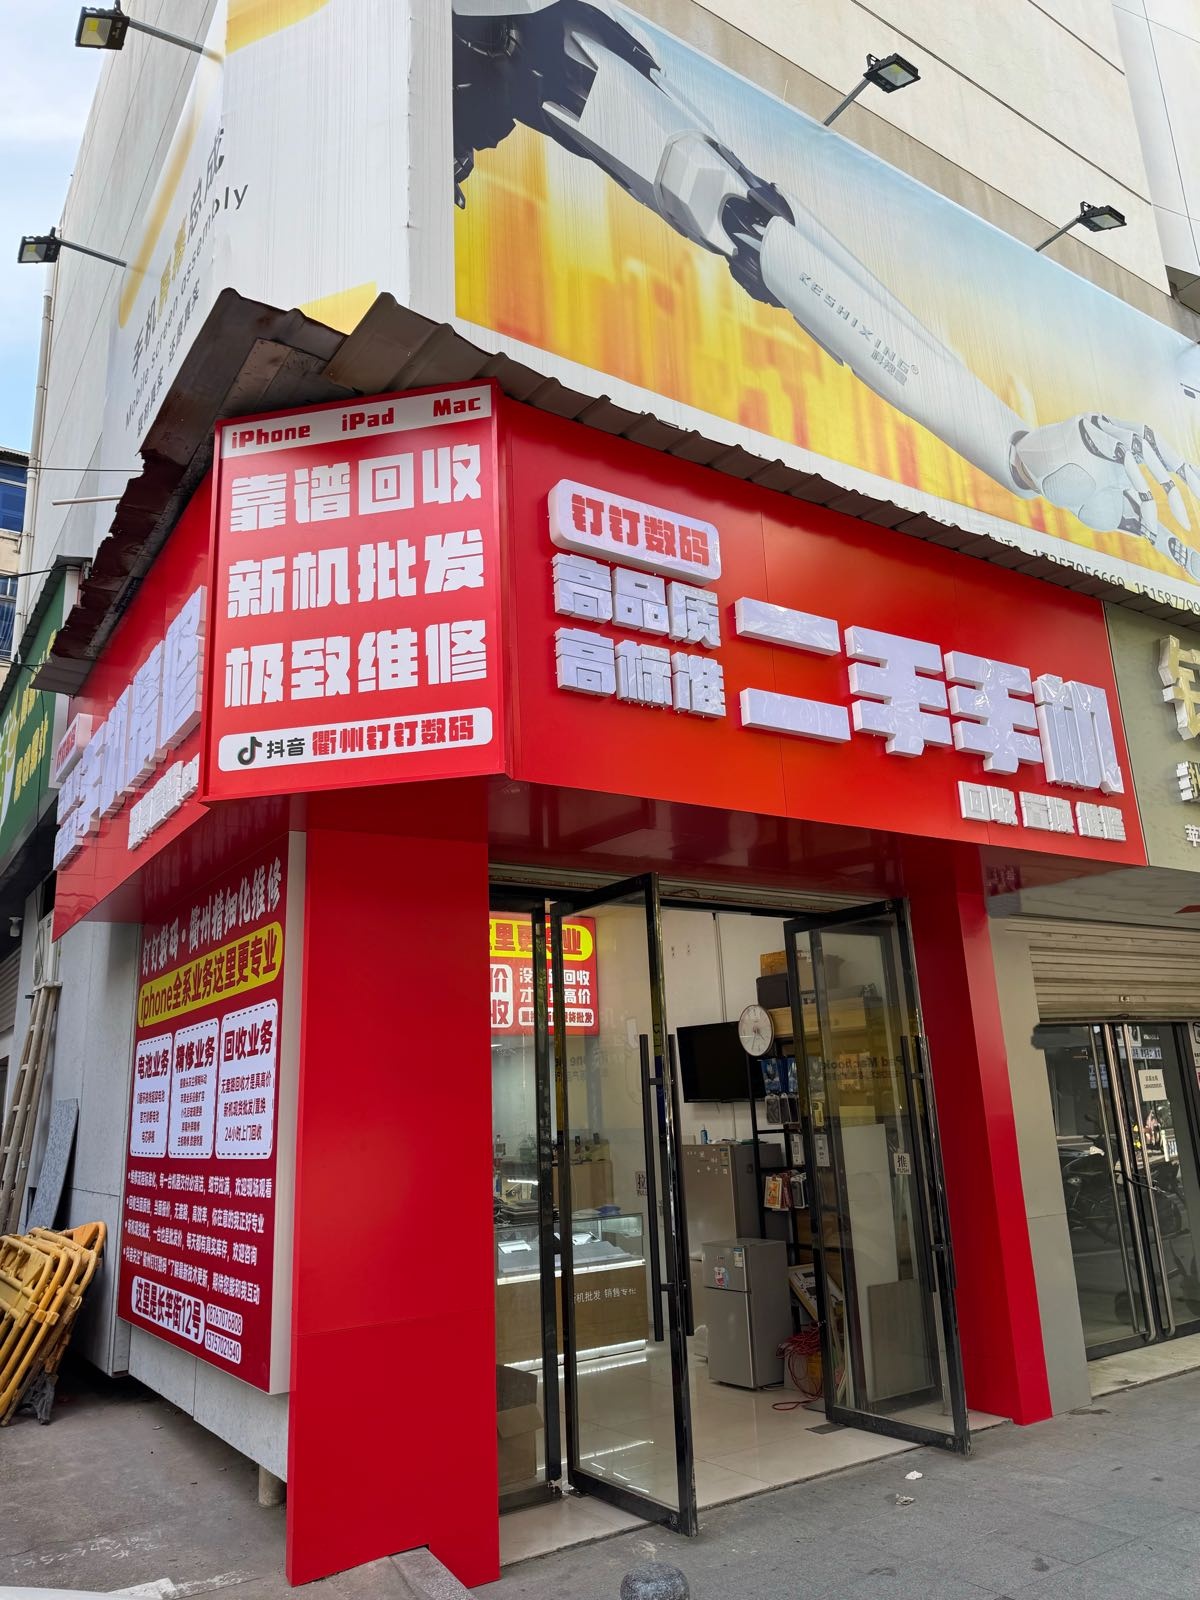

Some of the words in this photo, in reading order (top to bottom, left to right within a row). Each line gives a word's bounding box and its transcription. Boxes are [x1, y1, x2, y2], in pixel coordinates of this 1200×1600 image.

[231, 422, 311, 449] iPhone
[341, 407, 395, 433] iPad
[433, 396, 482, 418] Mac
[230, 442, 482, 533] 靠谱回收
[571, 492, 710, 567] 钉钉数码
[227, 527, 485, 619] 新机批发
[551, 551, 722, 650] 高品质
[224, 618, 488, 709] 极致维修
[554, 627, 727, 719] 高标准
[734, 596, 1125, 796] 二手手机
[266, 735, 306, 760] 抖音
[311, 713, 475, 757] 衢州钉钉数码
[957, 780, 1019, 827] 回收
[1075, 801, 1128, 842] 维修
[137, 1048, 170, 1080] 电池业务
[175, 1036, 216, 1074] 精修业务
[223, 1019, 274, 1063] 回收业务
[224, 1124, 263, 1142] 24小时上门回收
